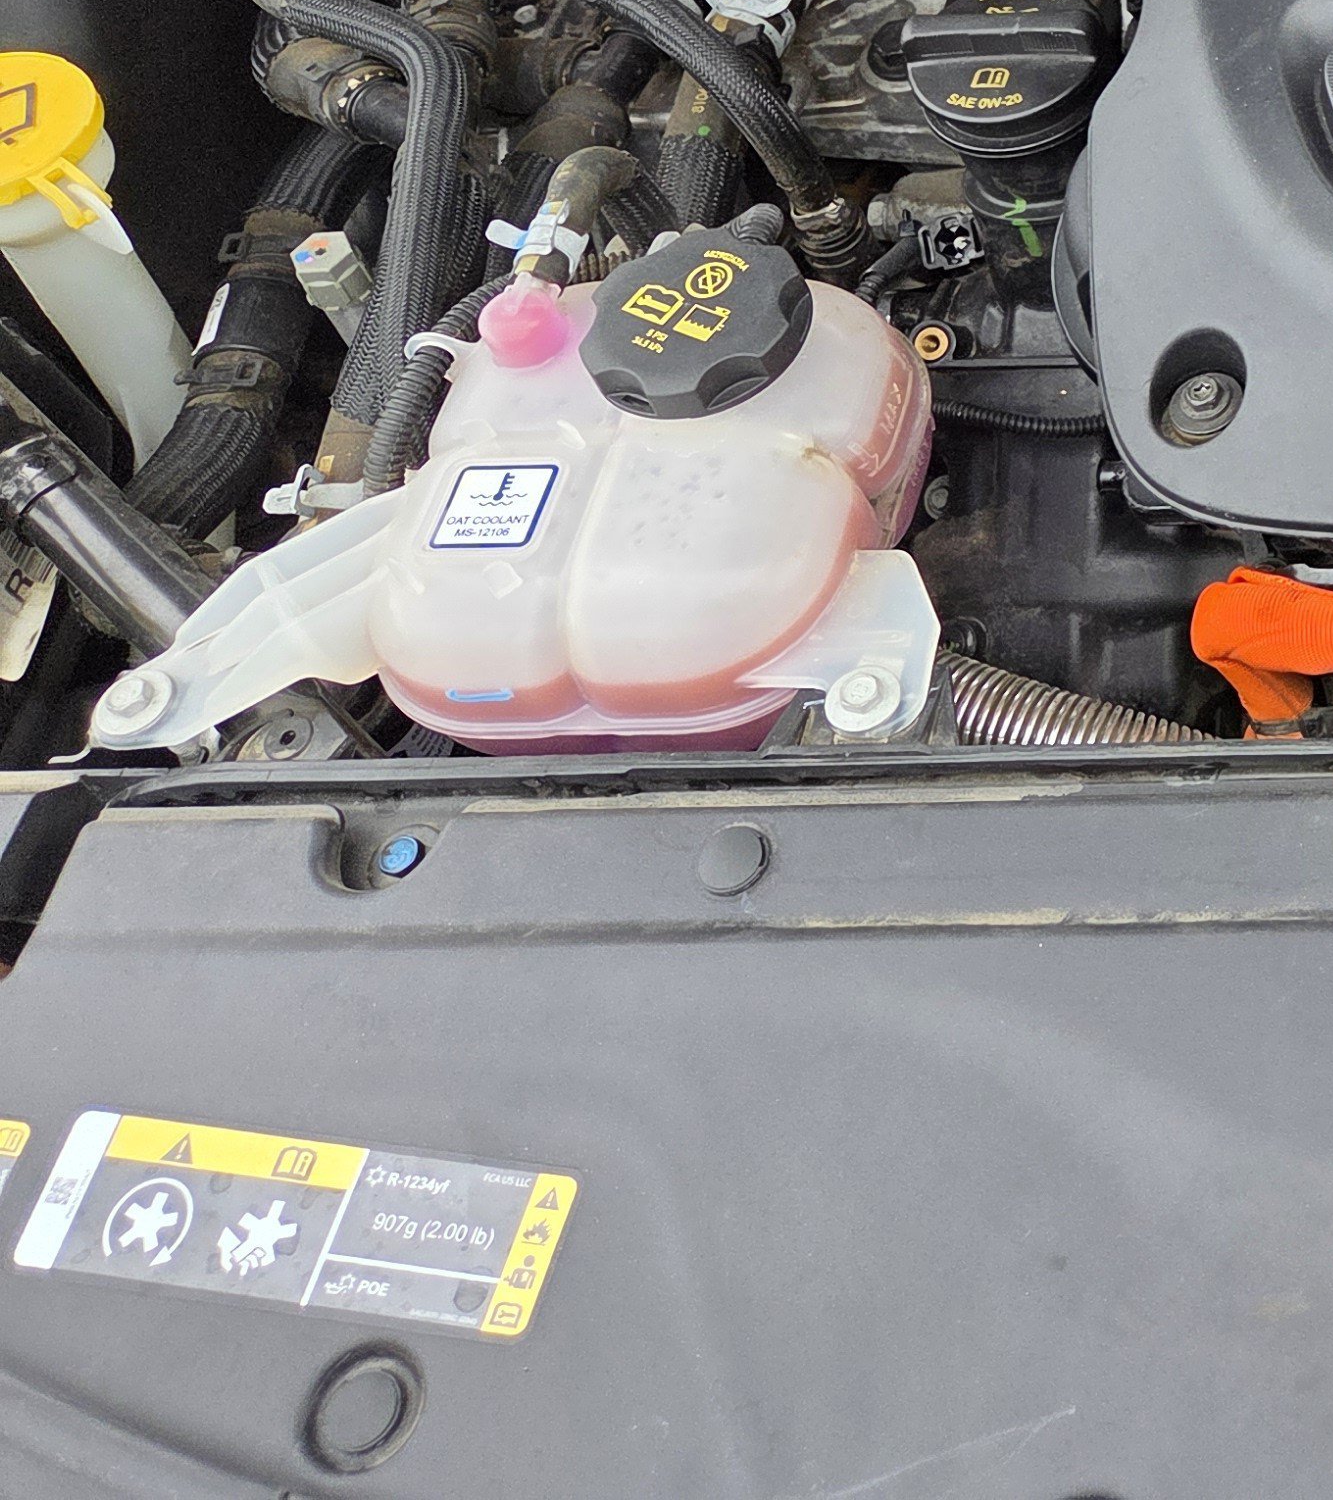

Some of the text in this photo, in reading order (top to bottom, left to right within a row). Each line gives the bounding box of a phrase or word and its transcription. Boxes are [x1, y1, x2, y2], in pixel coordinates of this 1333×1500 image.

[946, 92, 1024, 111] SAE 0W-20
[446, 515, 530, 526] OAT COOLANT
[454, 528, 511, 538] MS-12106
[386, 1173, 452, 1195] R-1234yf
[484, 1172, 532, 1188] FCA US LLC
[372, 1212, 496, 1250] 907g (2.00 lb)
[356, 1280, 392, 1297] POE
